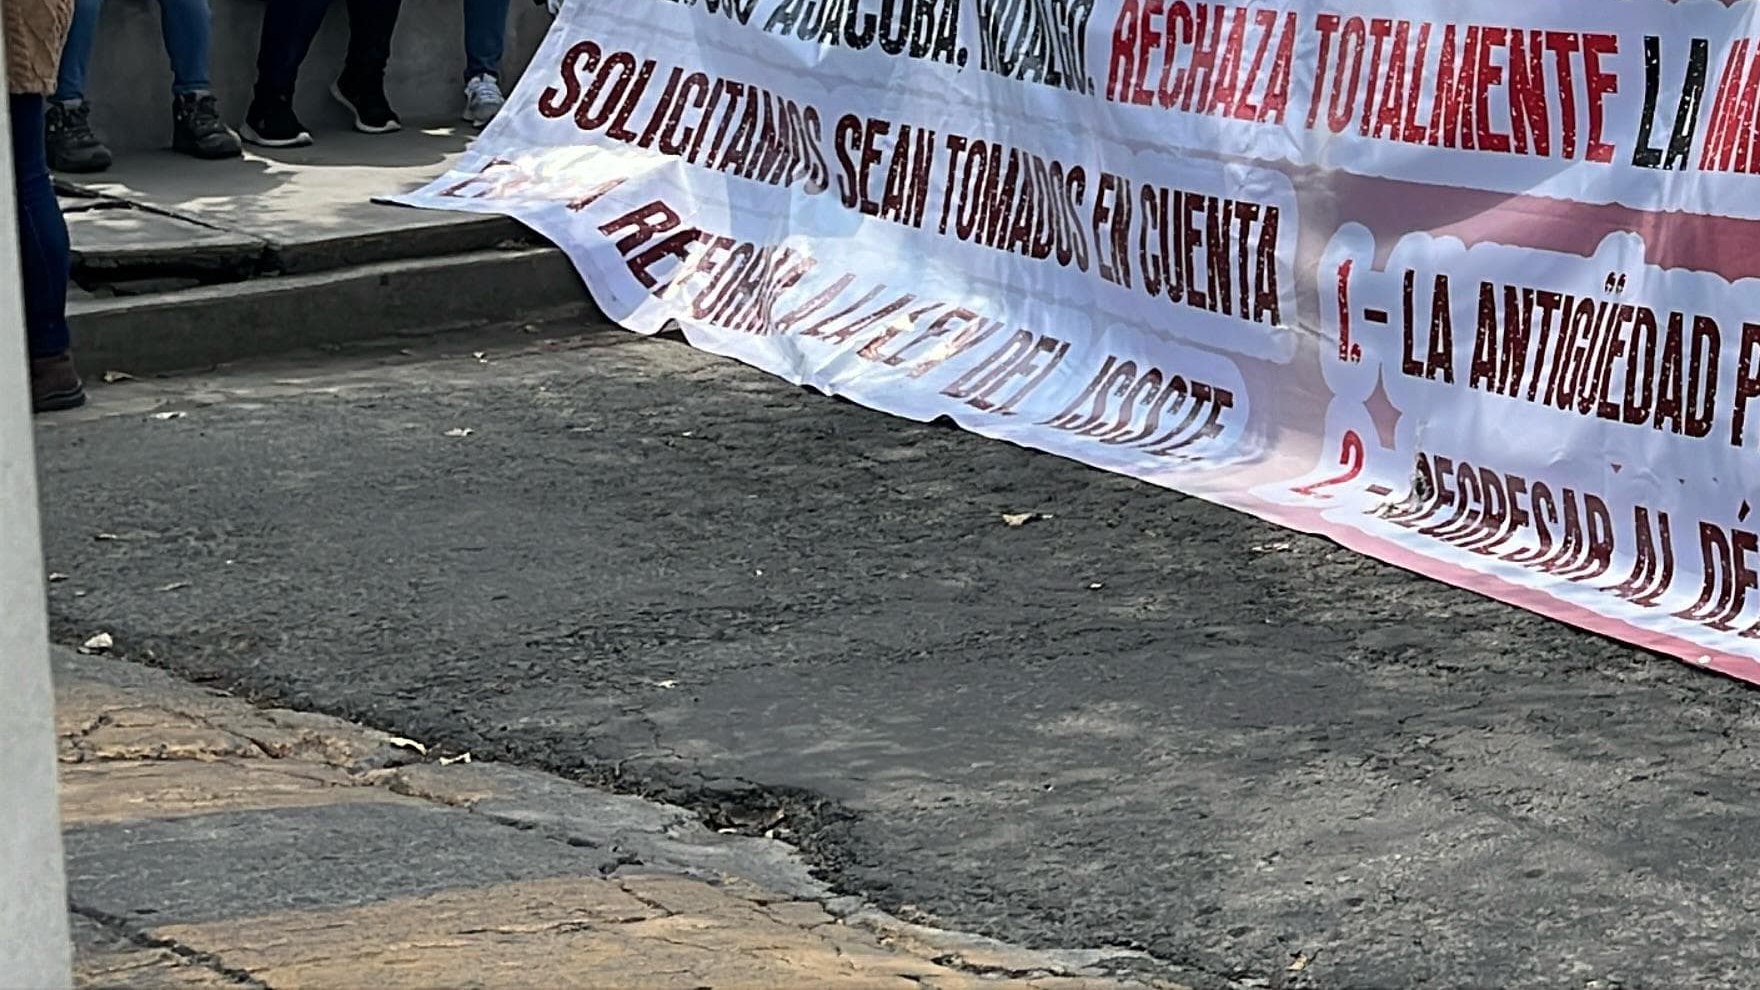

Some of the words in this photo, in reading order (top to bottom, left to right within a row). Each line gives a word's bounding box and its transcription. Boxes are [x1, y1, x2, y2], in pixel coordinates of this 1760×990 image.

[1307, 13, 1618, 165] TOTALMENTE
[1632, 35, 1709, 170] LA
[538, 40, 830, 196] SOLICITAMOS
[836, 114, 936, 229] SEAN
[939, 135, 1089, 273] TOMADOS
[1092, 171, 1132, 290] EN
[1139, 184, 1282, 327] CUENTA
[1402, 269, 1455, 384] LA
[1470, 271, 1720, 439] ANTIGÜEDAD
[1599, 504, 1674, 608] AL
